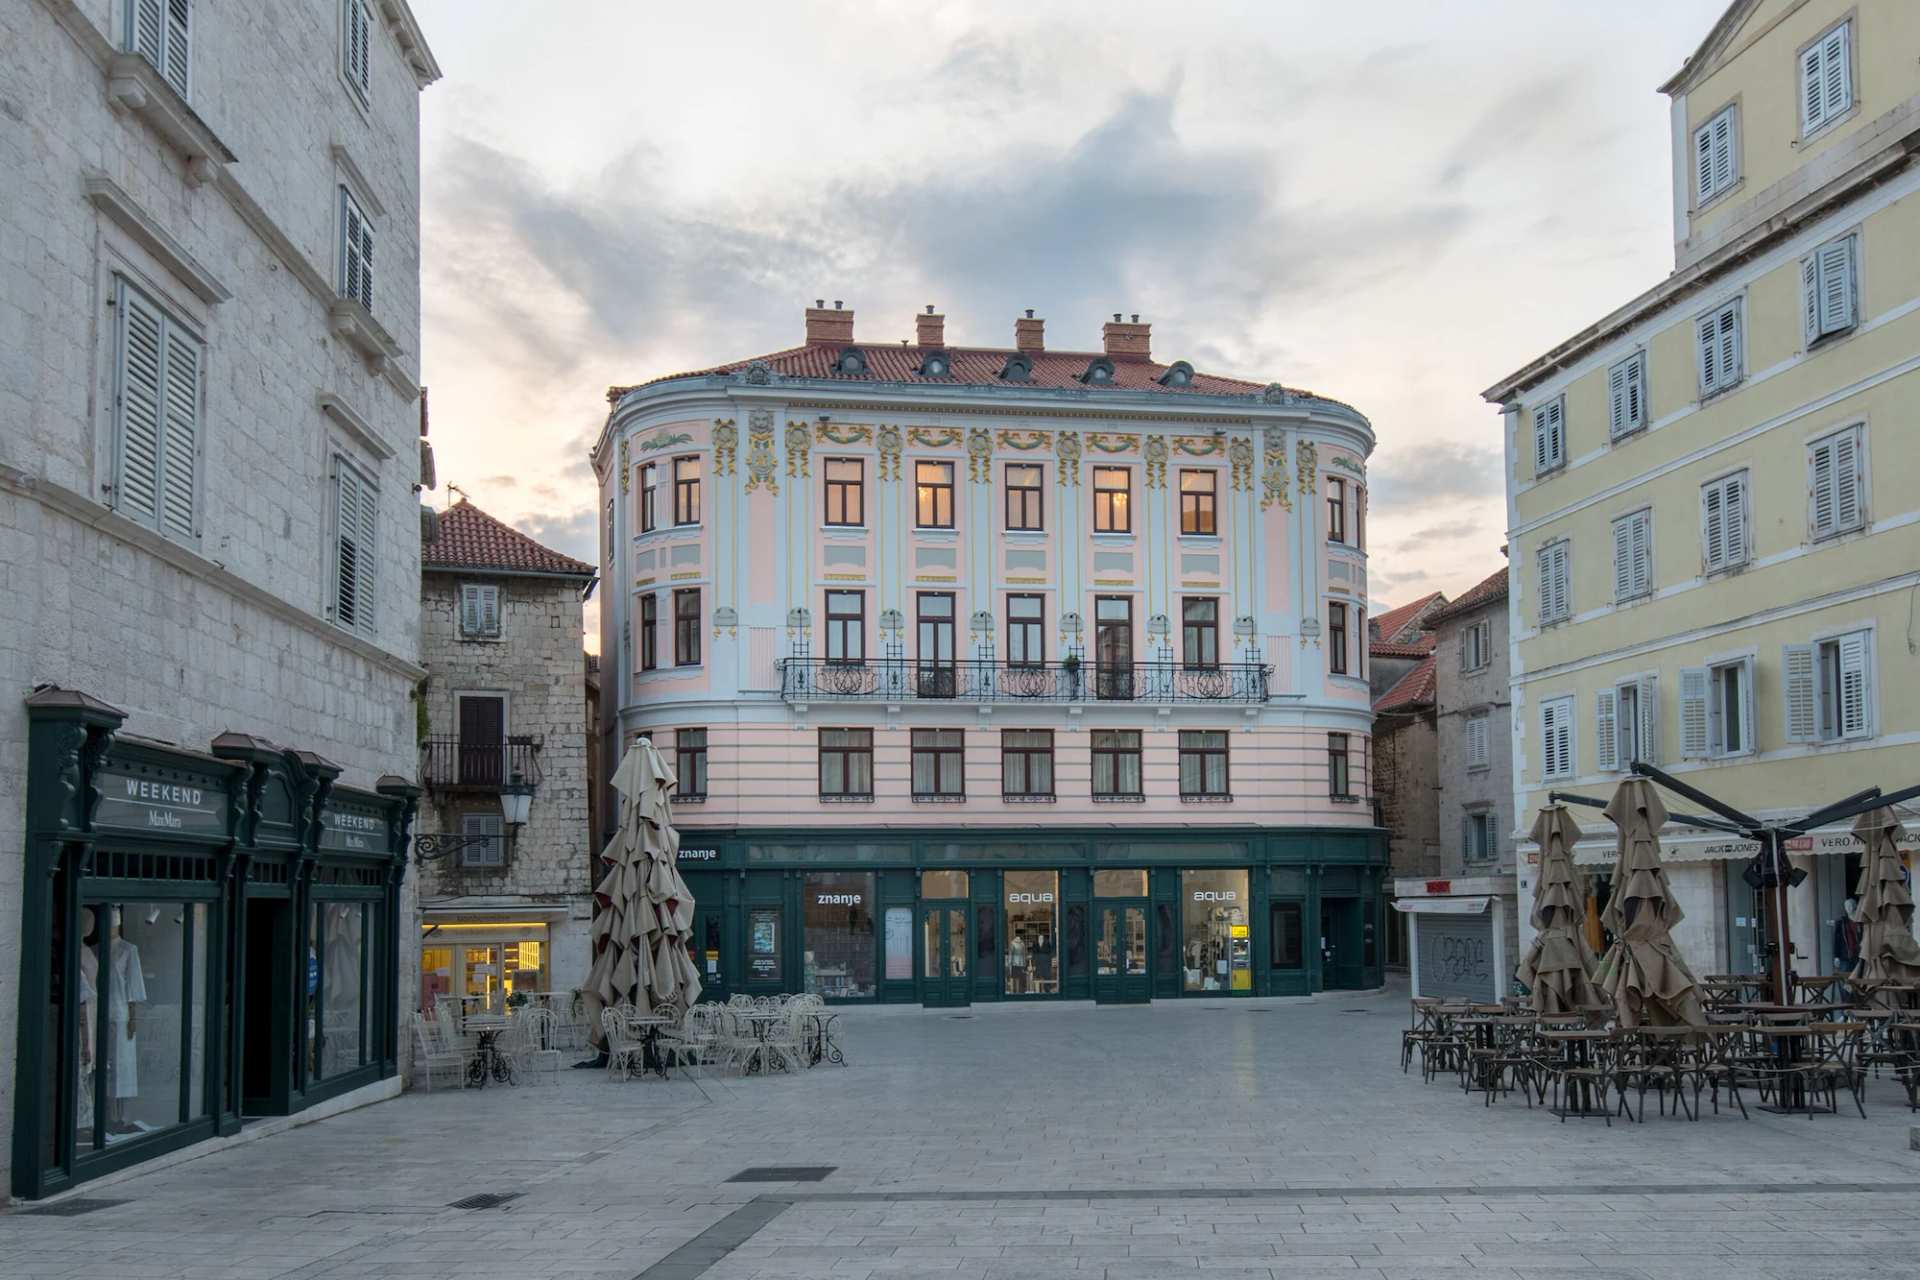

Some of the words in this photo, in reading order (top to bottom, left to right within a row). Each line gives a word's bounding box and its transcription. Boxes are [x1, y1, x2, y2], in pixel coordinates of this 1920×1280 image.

[126, 779, 202, 805] WEEKEND
[1821, 837, 1851, 848] VERO
[679, 849, 717, 860] znanje
[818, 893, 862, 906] znanje
[1009, 892, 1054, 905] aqua
[1193, 890, 1237, 903] aqua
